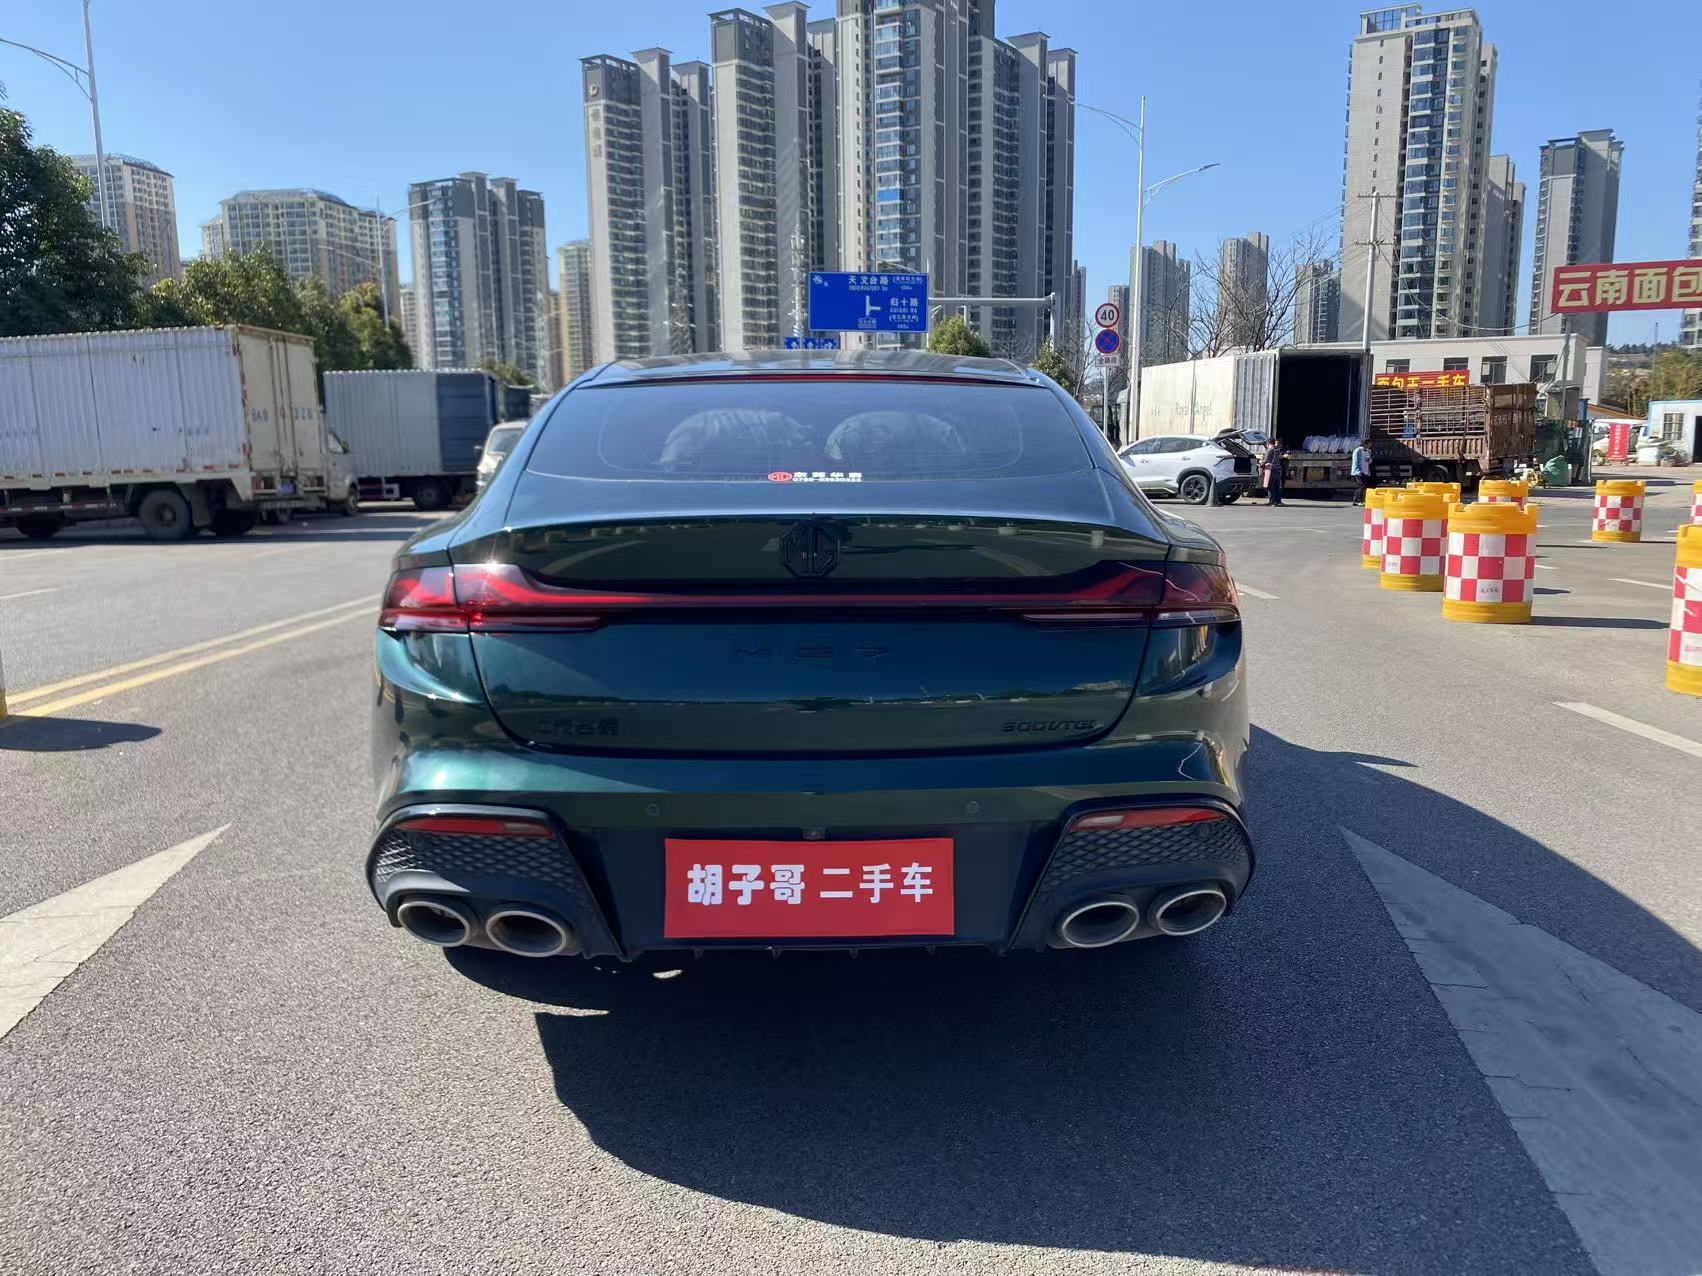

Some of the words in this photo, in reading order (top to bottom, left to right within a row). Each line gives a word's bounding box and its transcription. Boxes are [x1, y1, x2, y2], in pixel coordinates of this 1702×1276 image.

[1558, 266, 1702, 307] 云南面包
[1100, 309, 1114, 321] 40
